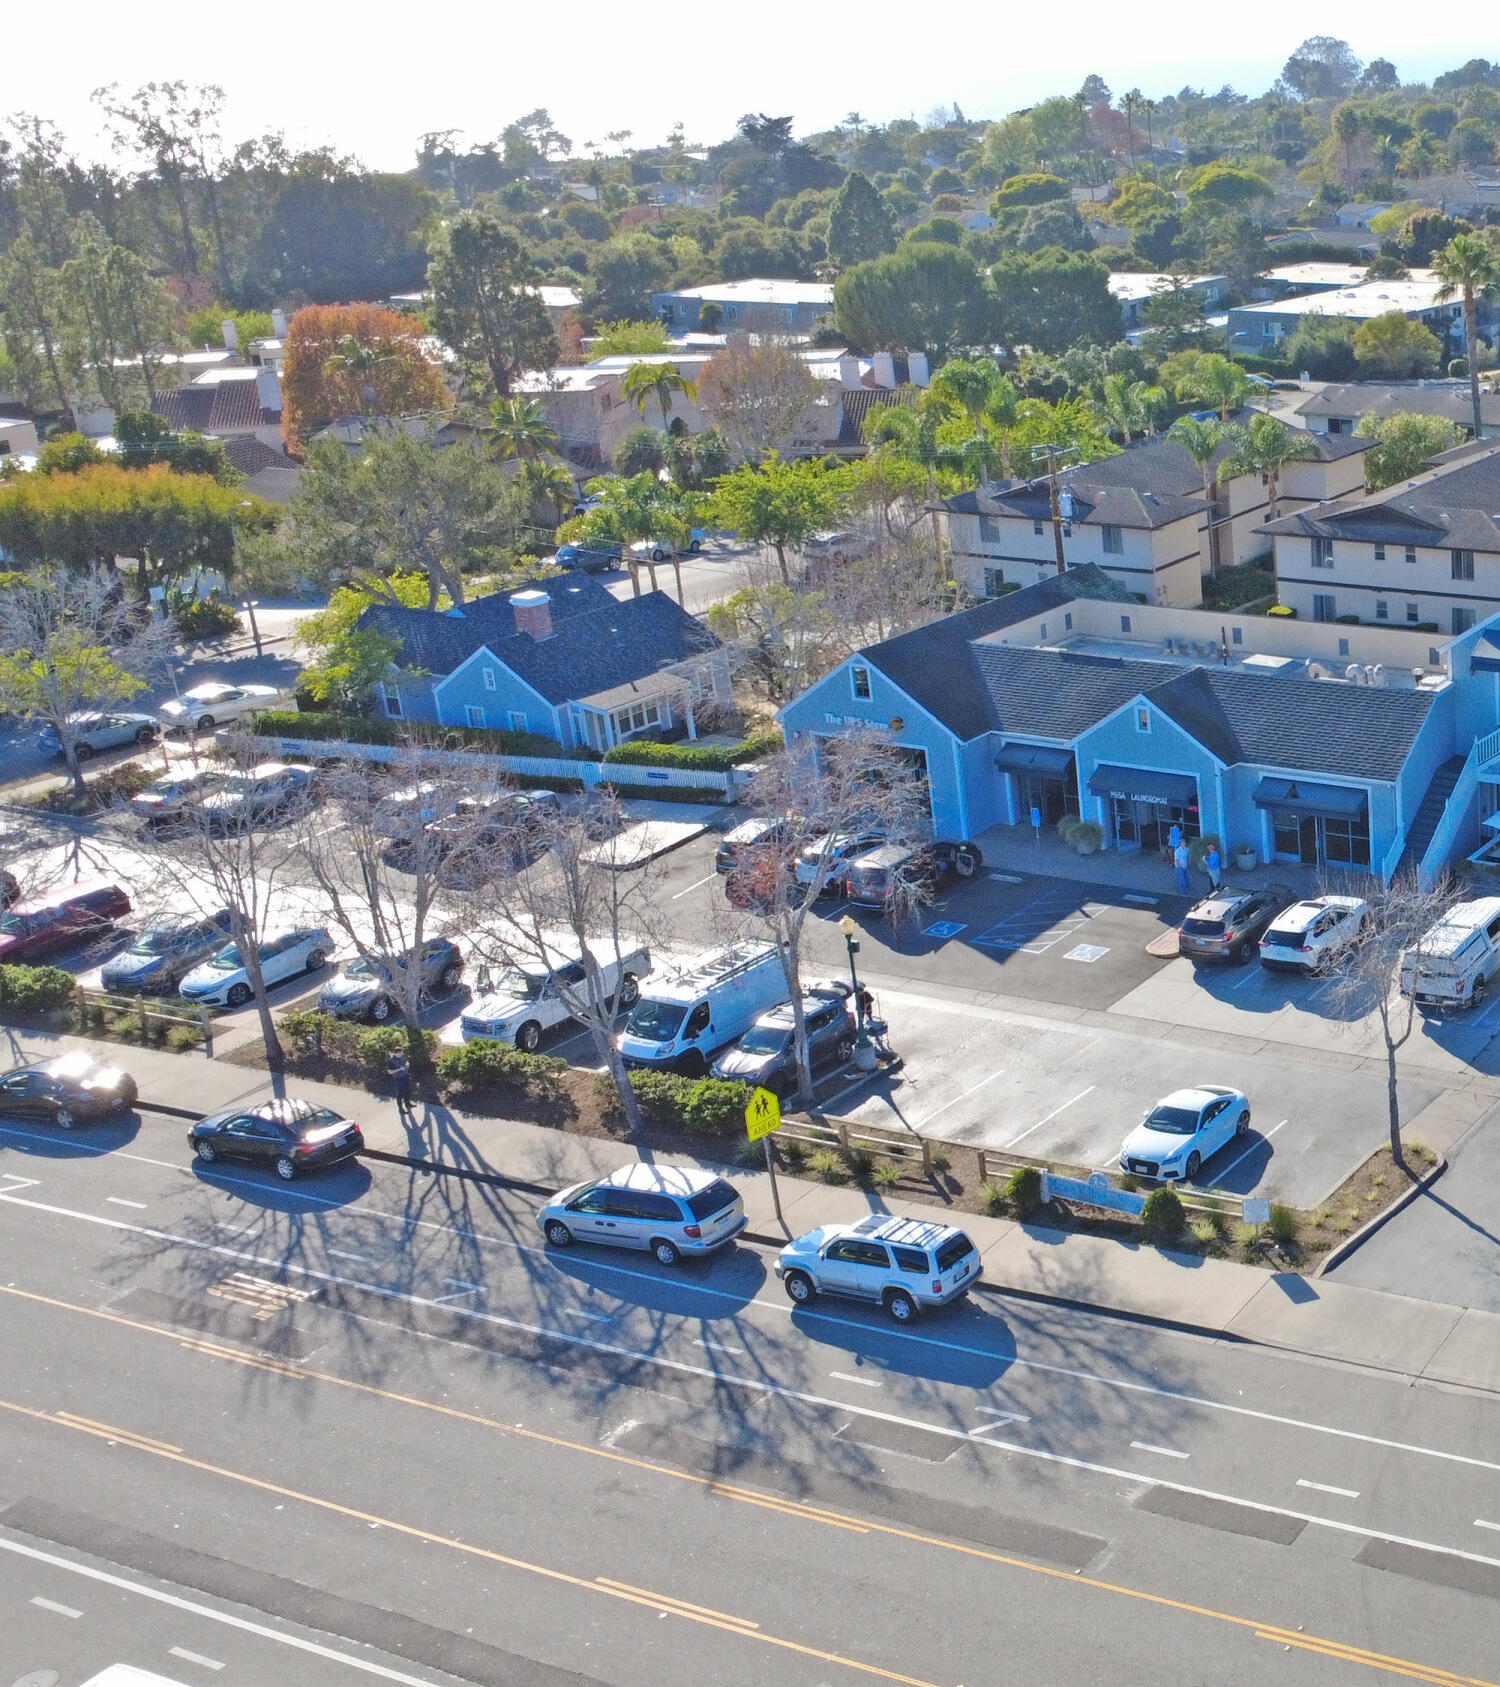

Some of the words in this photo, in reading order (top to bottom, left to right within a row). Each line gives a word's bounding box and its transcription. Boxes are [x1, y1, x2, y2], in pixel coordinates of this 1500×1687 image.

[824, 713, 842, 725] The
[1110, 790, 1126, 800] MESA
[1130, 793, 1168, 805] LAUNDROMAT
[753, 1118, 777, 1137] AHEAD
